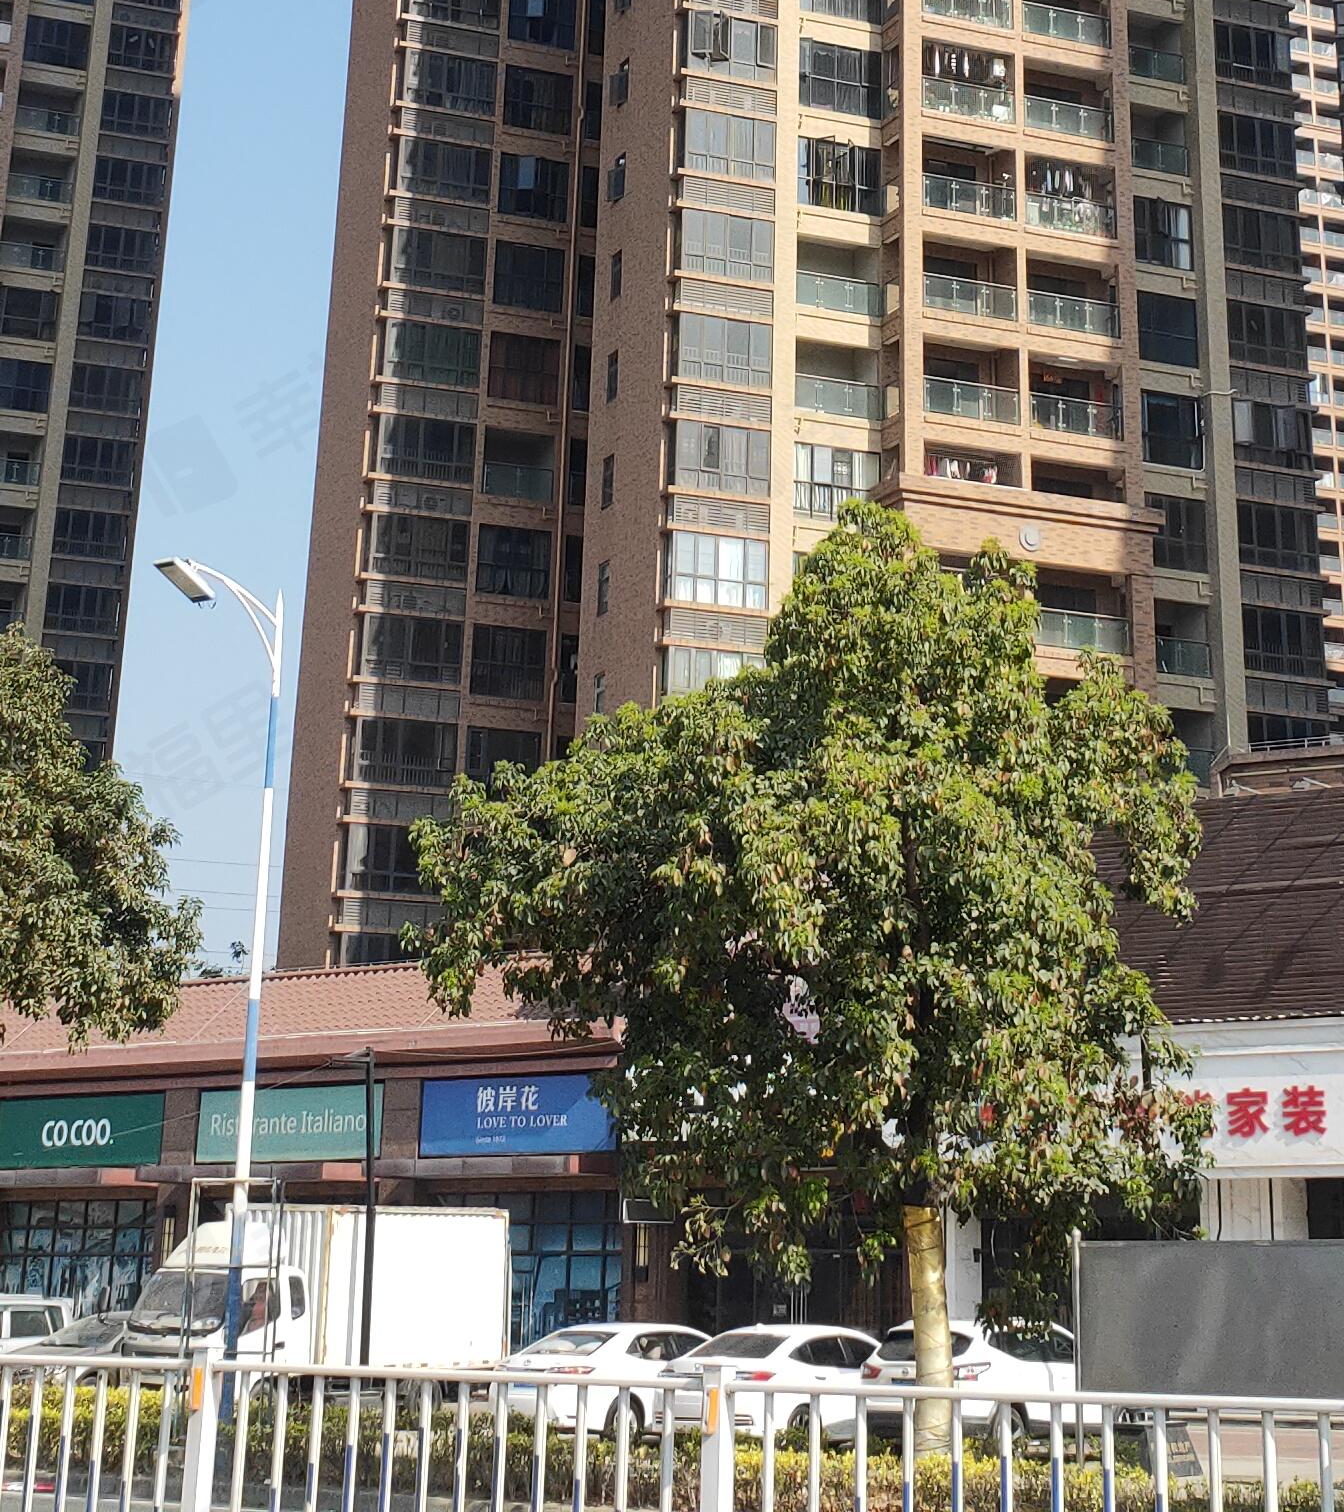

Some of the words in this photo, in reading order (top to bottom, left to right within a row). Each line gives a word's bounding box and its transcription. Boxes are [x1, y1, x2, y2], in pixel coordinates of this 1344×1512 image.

[477, 1085, 539, 1113] 彼岸花
[210, 1113, 297, 1137] Ristrante
[301, 1110, 367, 1135] Italiano
[477, 1117, 506, 1129] LOVE
[509, 1116, 526, 1128] TO
[530, 1114, 568, 1127] LOVER
